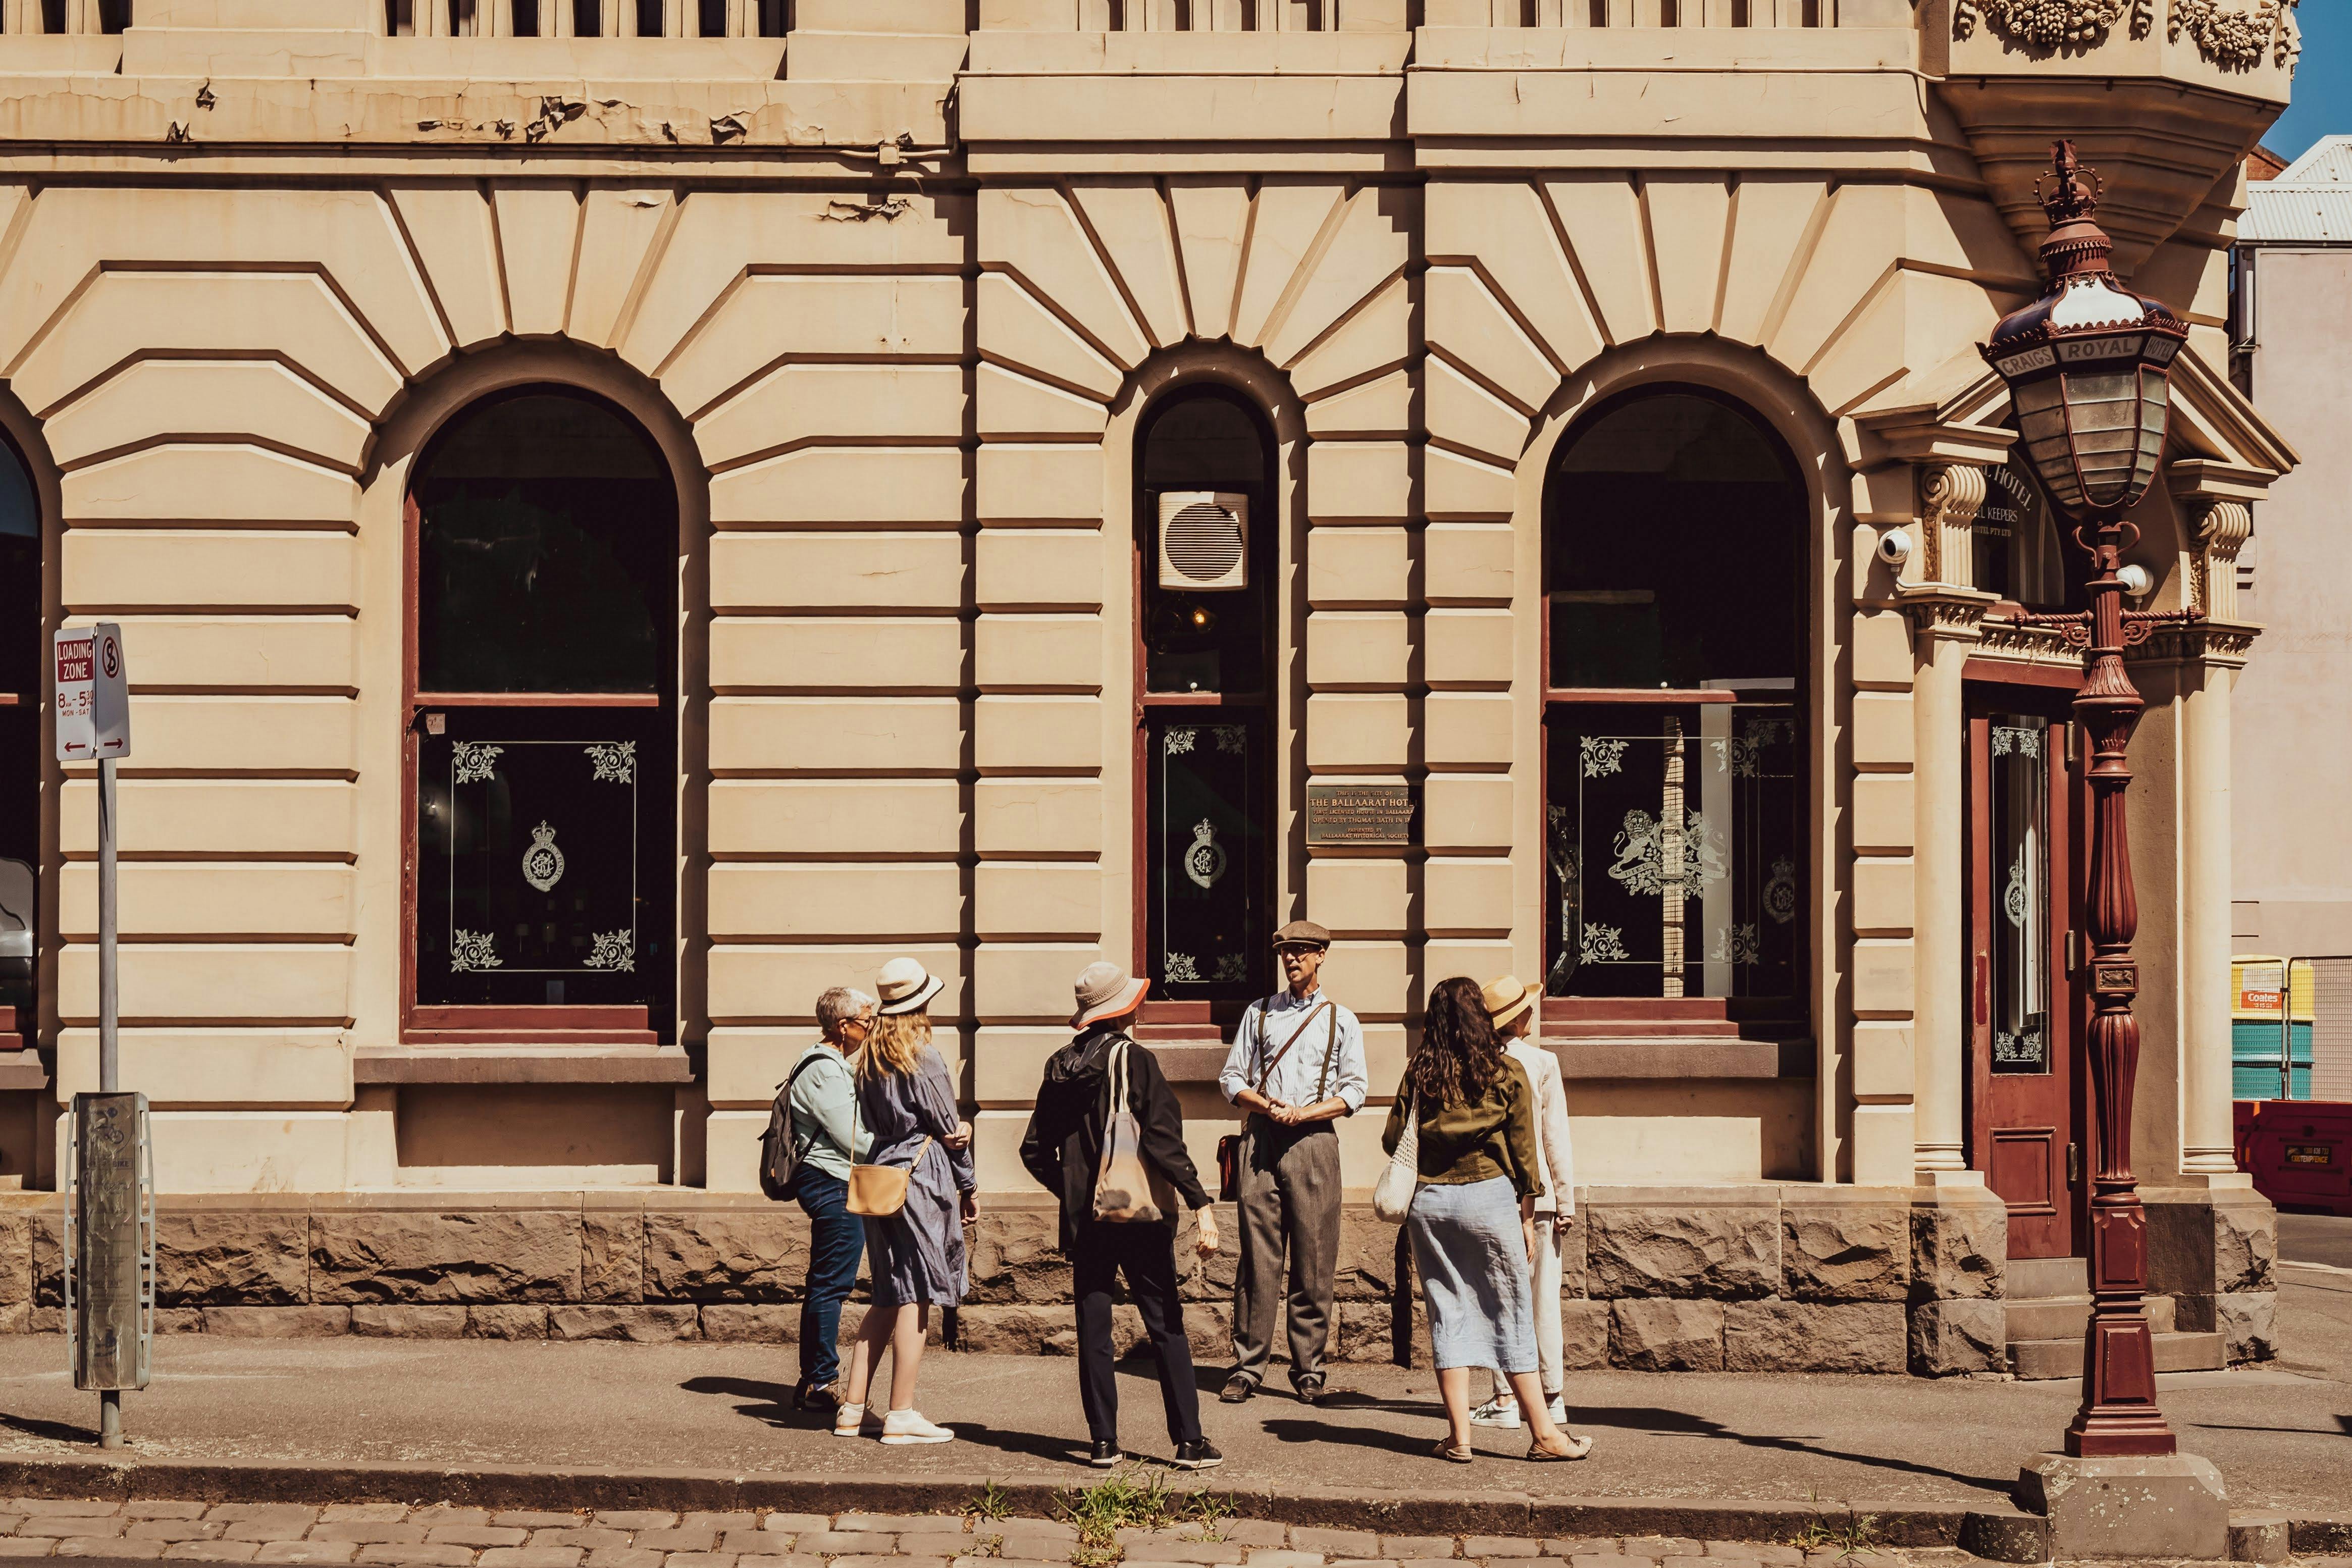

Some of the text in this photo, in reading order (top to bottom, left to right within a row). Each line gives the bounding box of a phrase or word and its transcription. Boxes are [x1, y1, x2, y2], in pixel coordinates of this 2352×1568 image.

[2068, 339, 2133, 358] ROYAL
[2146, 339, 2174, 358] HOTEL
[1994, 464, 2031, 511] HOTEL
[1988, 506, 2018, 522] KEEPERS
[1990, 528, 2001, 536] PTY
[58, 642, 92, 660] LOADING
[64, 662, 88, 680] ZONE
[1310, 799, 1329, 807] THE
[1332, 799, 1387, 807] BALLAARAT
[1625, 864, 1649, 877] DIEU
[2248, 993, 2278, 1003] Coates
